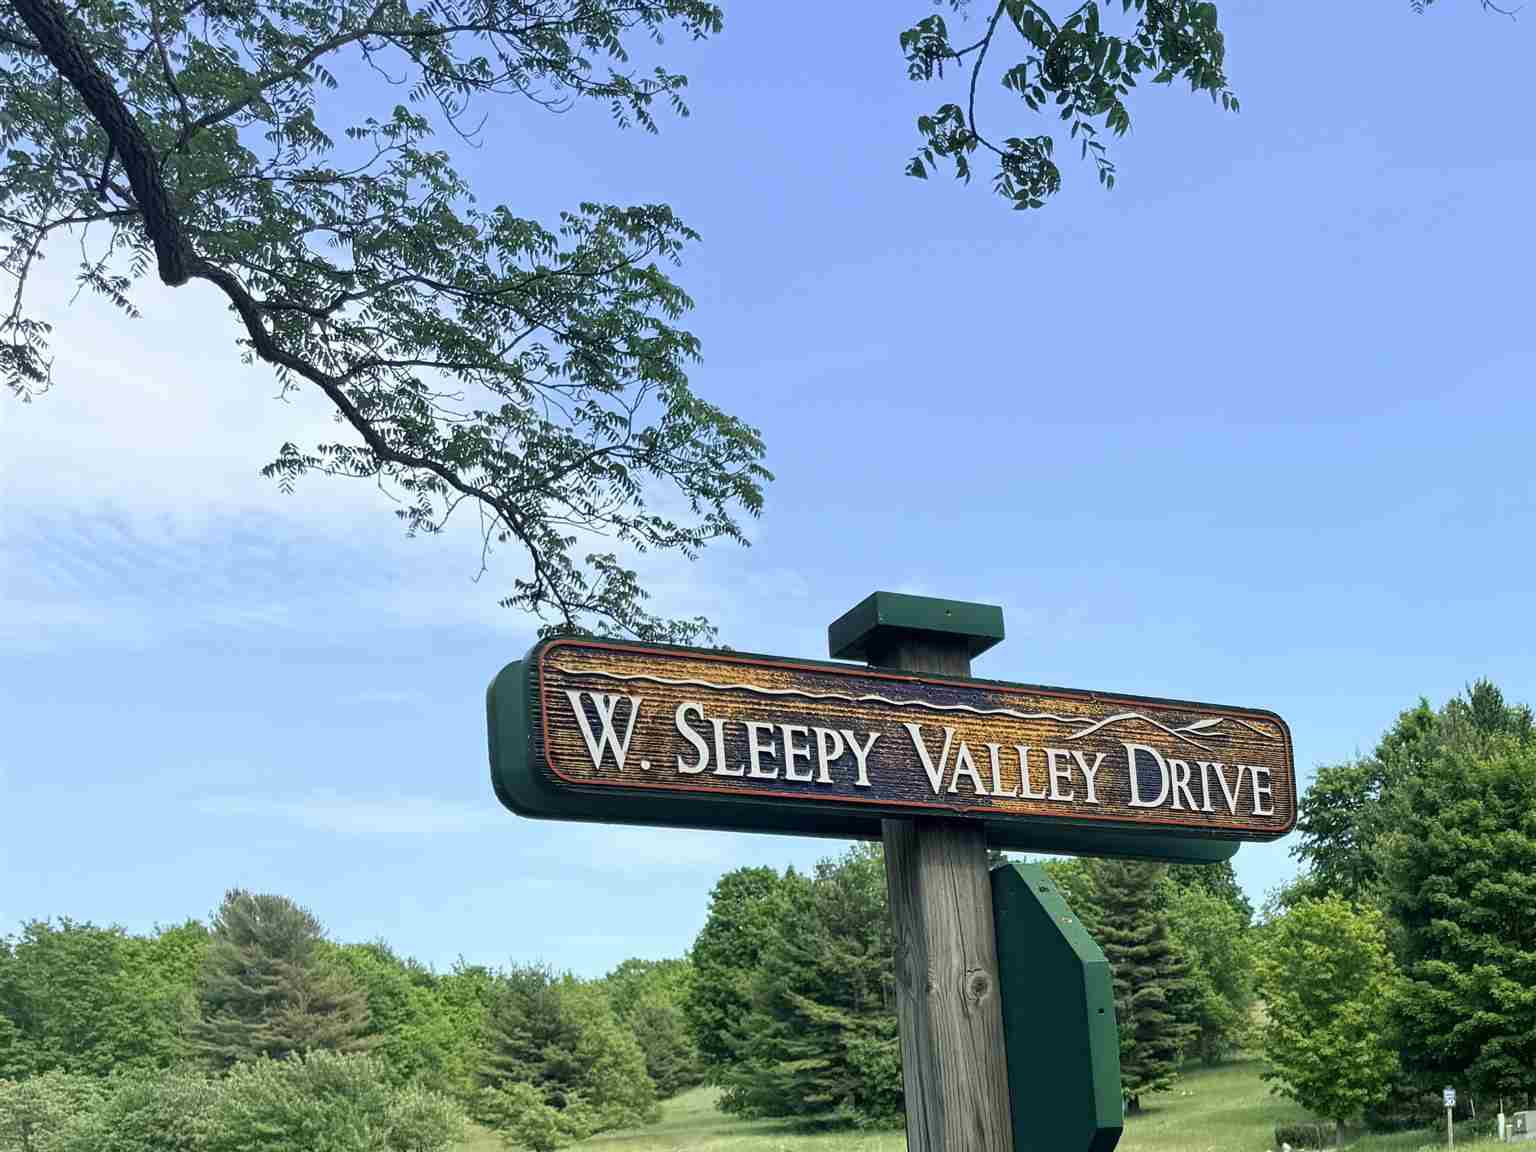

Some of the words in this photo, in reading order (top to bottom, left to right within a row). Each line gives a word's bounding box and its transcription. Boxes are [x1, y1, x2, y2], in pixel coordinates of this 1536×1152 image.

[563, 690, 651, 771] W.
[675, 702, 880, 786] SLEEPY
[904, 723, 1106, 803] VALLEY
[1121, 743, 1275, 816] DRIVE
